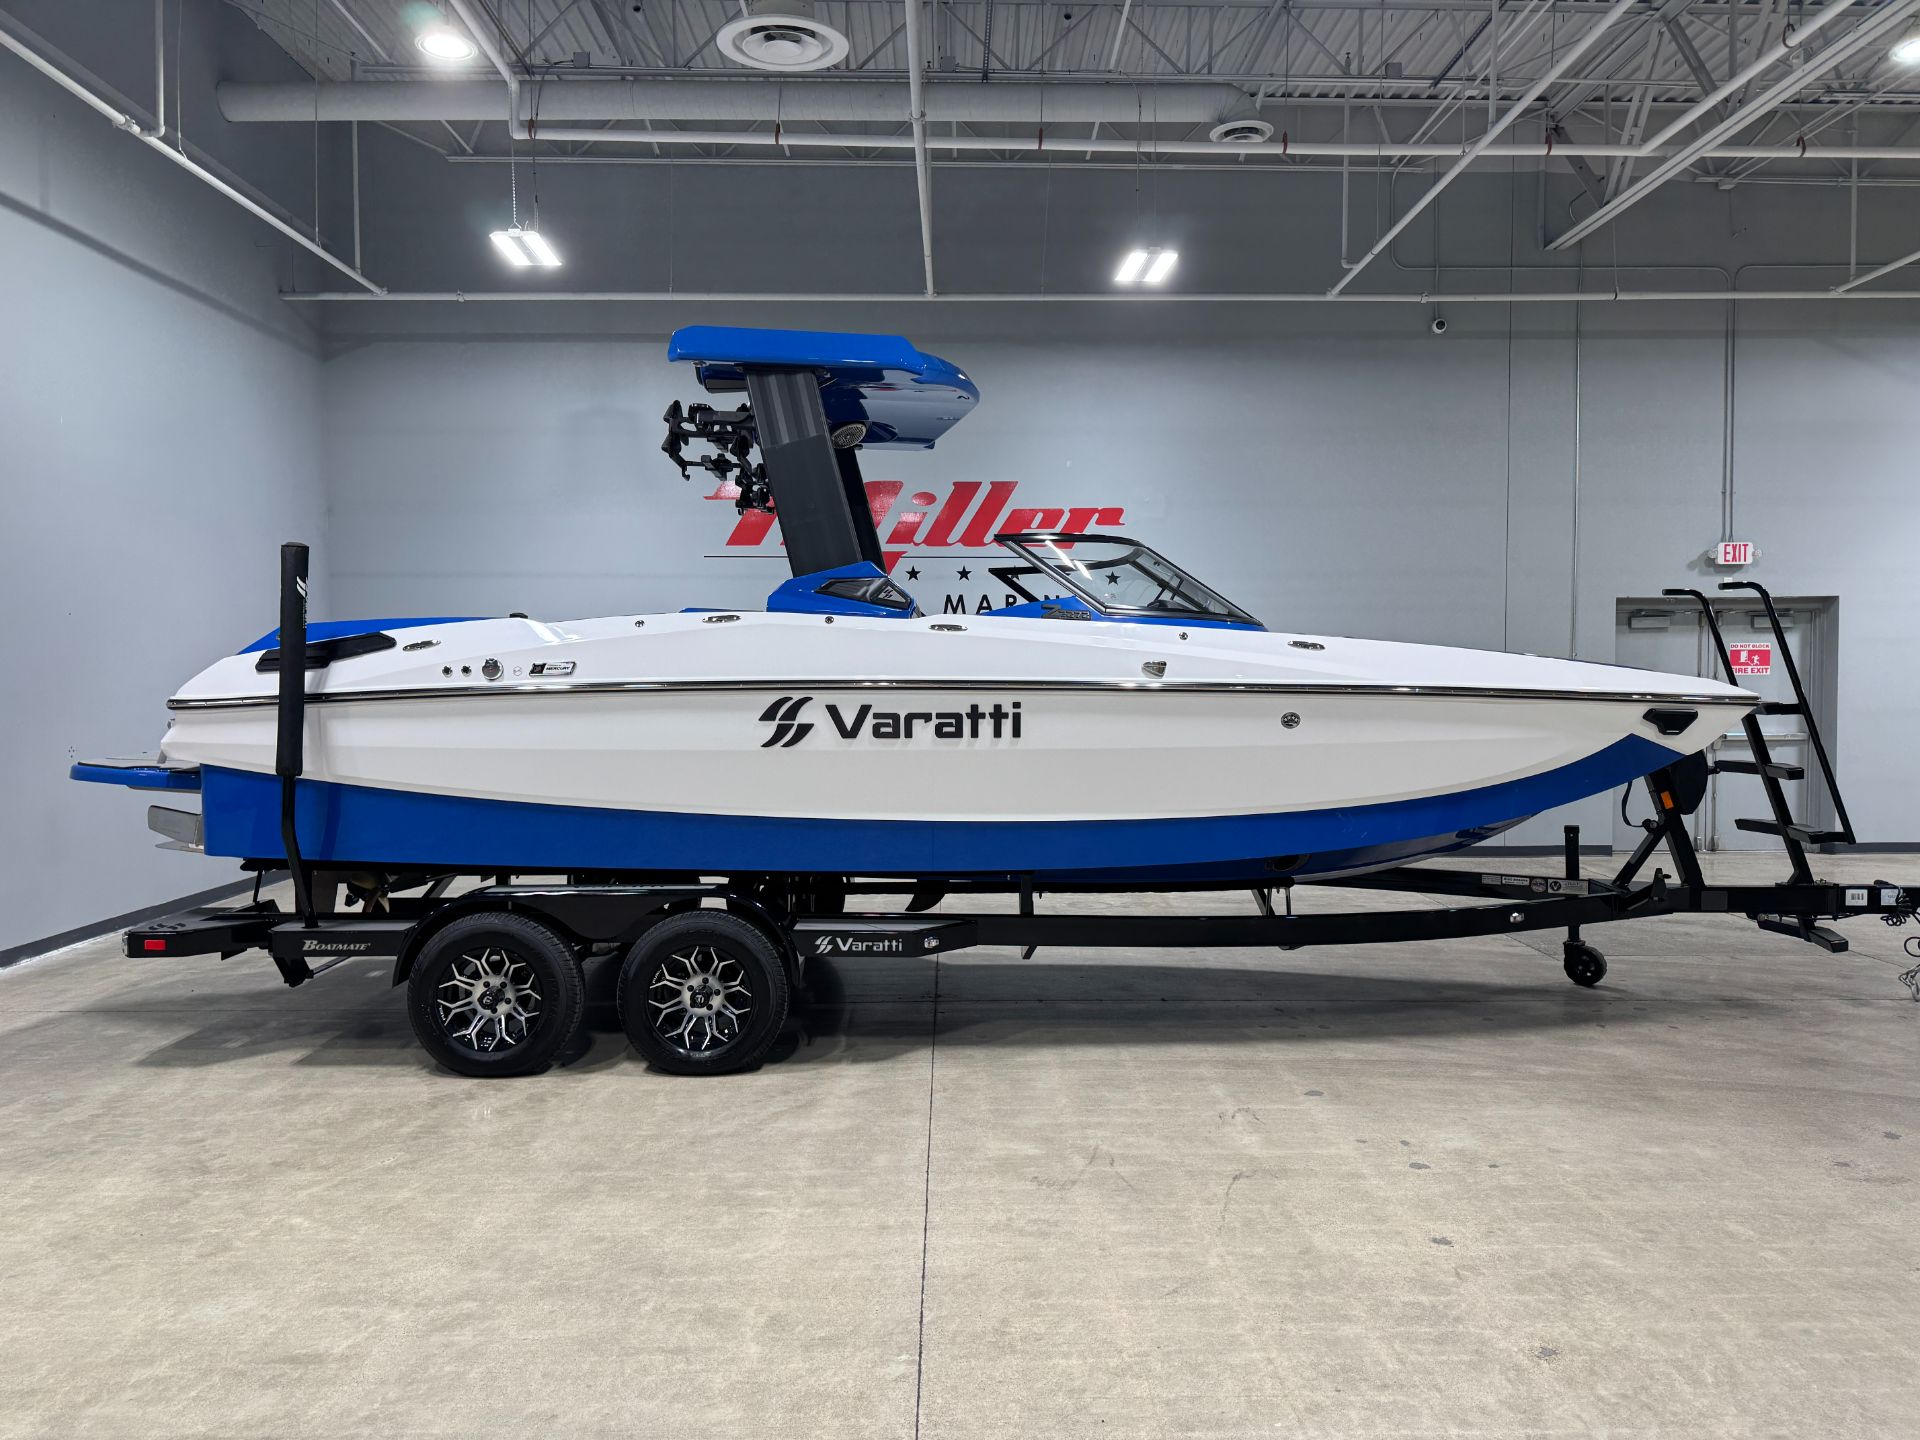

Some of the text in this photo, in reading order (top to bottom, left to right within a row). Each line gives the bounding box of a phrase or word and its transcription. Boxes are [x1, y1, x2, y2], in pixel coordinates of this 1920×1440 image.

[1724, 544, 1749, 563] EXIT
[825, 702, 1021, 739] Varatti
[302, 939, 369, 951] BOATMATE
[835, 937, 903, 952] Varatti
